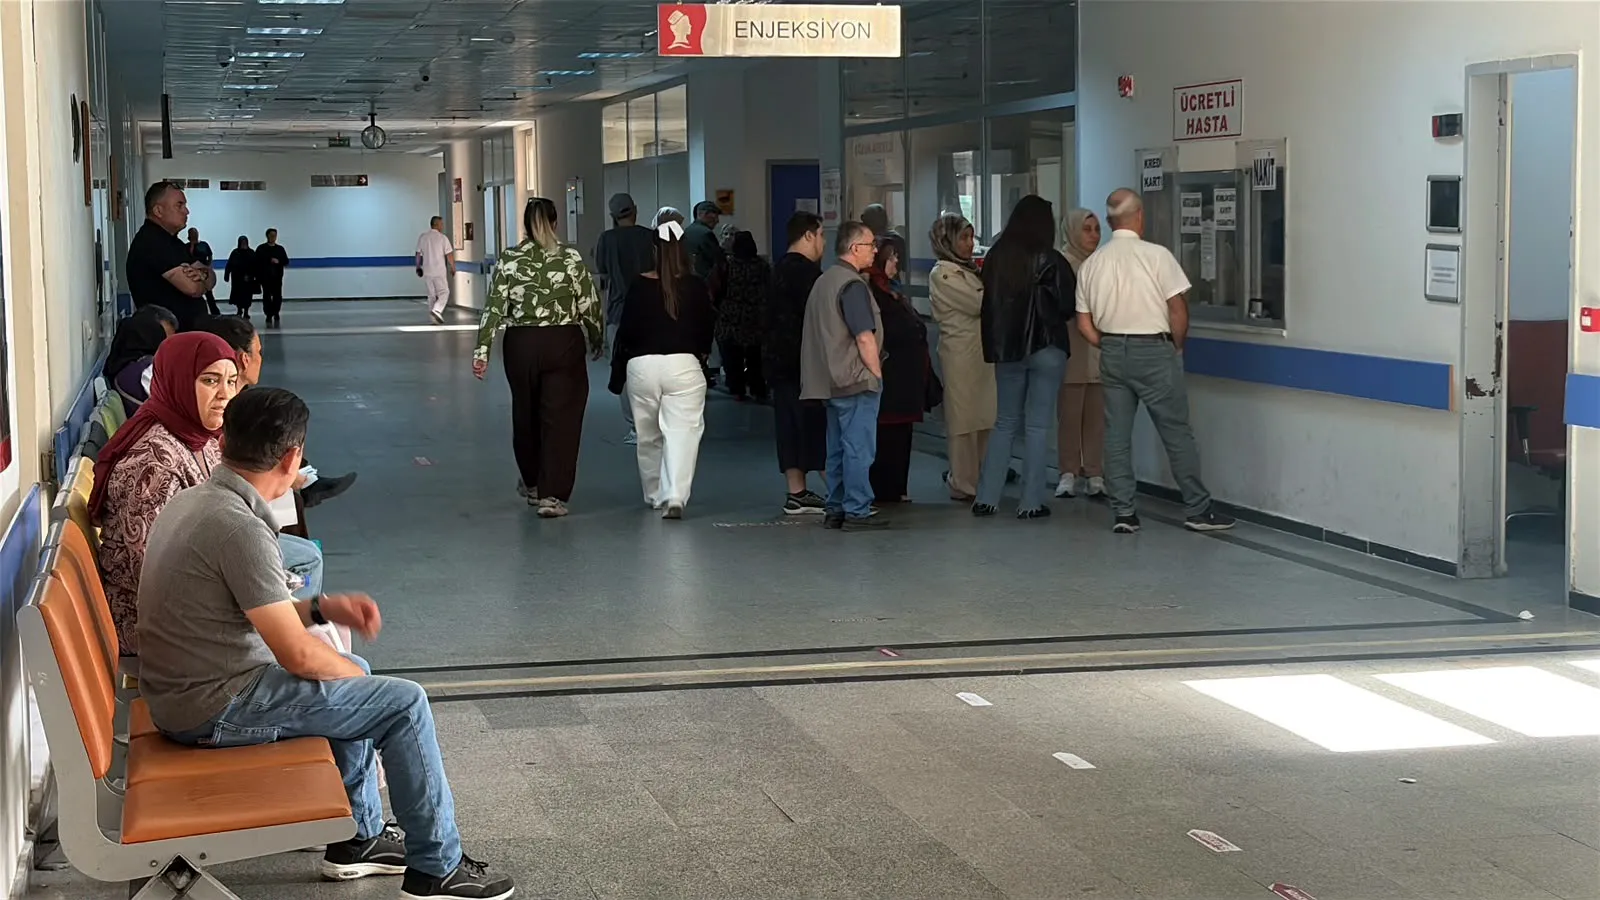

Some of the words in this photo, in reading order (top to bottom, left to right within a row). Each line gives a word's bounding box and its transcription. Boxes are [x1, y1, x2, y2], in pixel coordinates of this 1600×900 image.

[735, 18, 871, 39] ENJEKSİYON
[1180, 85, 1235, 112] ÜCRETLİ
[1186, 114, 1228, 135] HASTA
[1144, 157, 1162, 169] KRED
